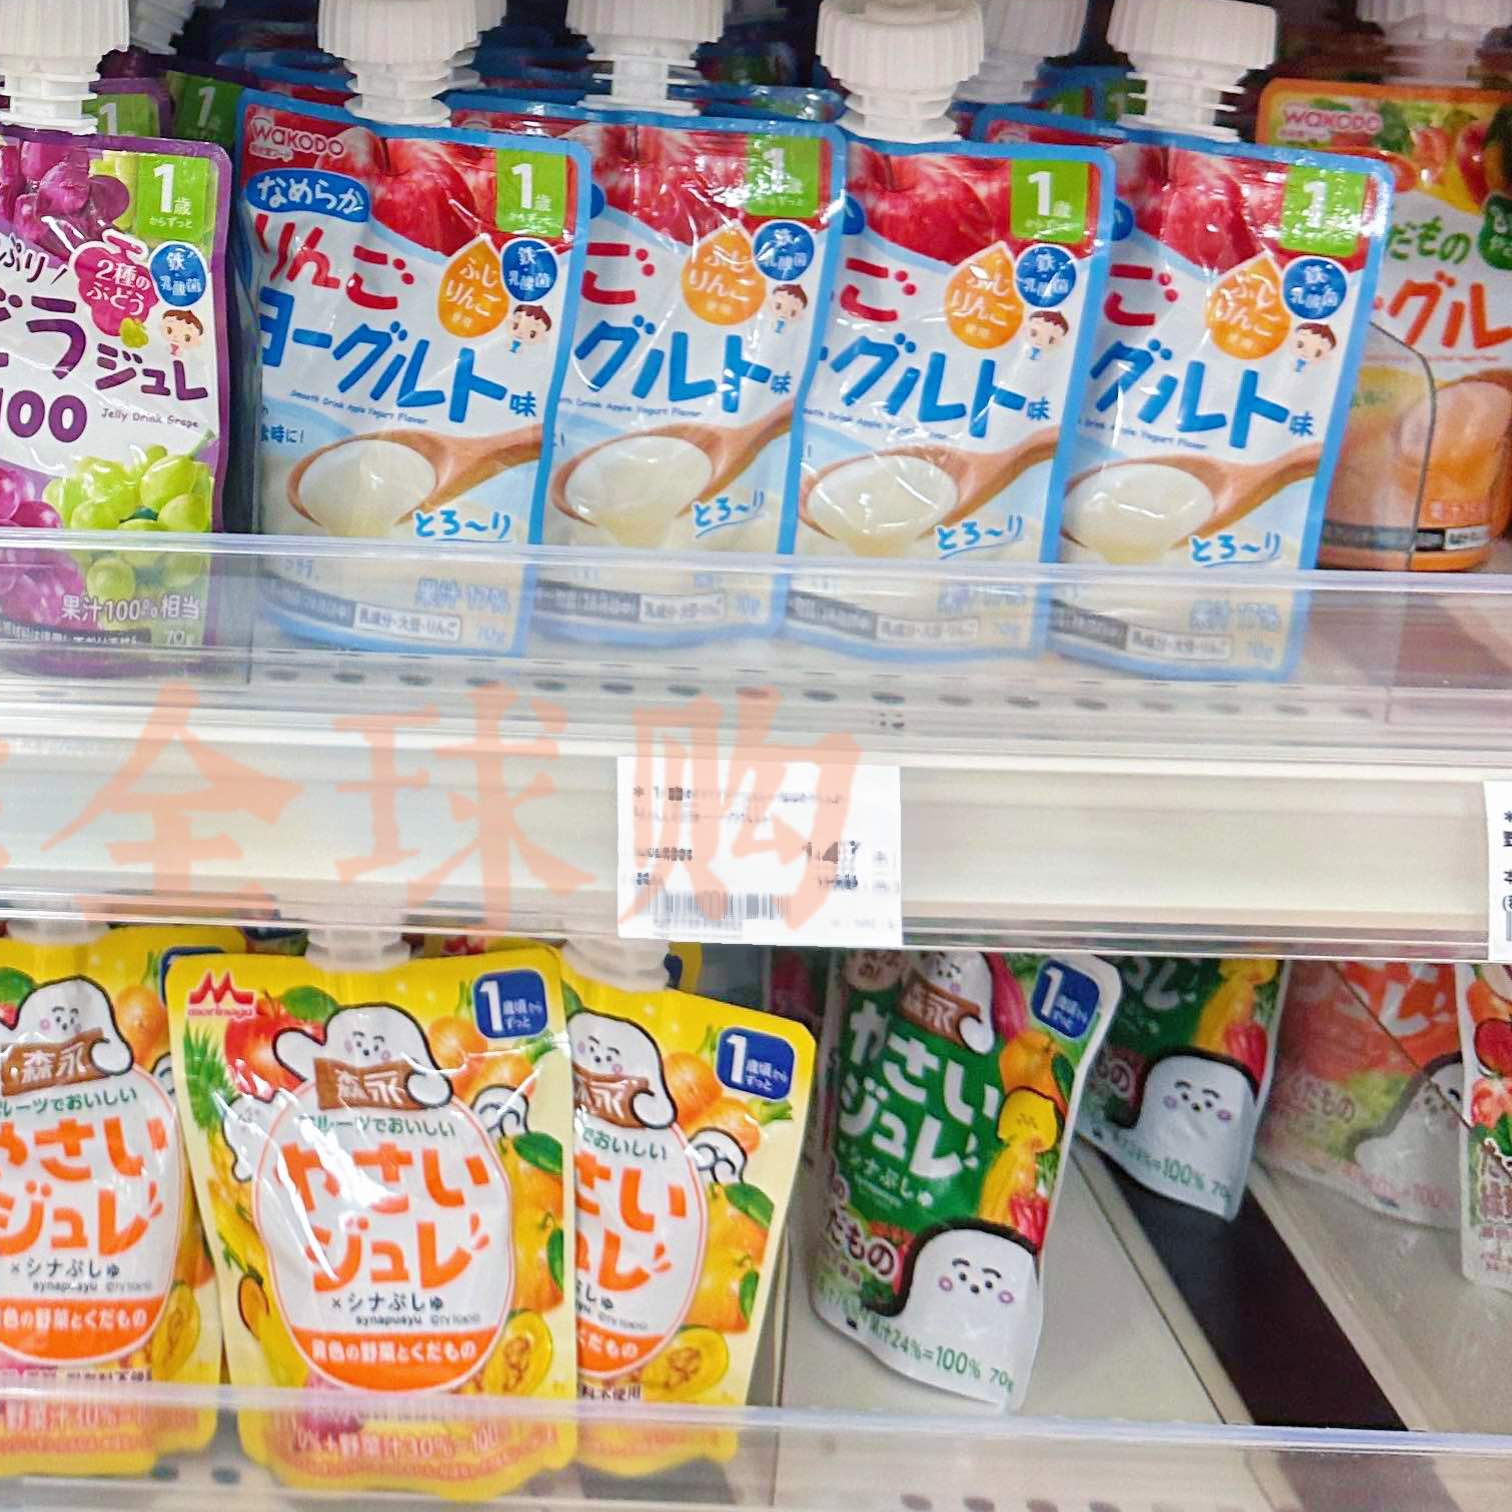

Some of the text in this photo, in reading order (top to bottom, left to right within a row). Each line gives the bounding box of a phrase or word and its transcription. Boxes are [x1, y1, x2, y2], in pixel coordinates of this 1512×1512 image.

[153, 163, 192, 216] 1歳
[256, 176, 366, 214] なめらか
[511, 162, 552, 214] 1歳
[95, 259, 149, 288] 2種の
[255, 212, 416, 312] りんご
[508, 268, 552, 291] 乳酸菌
[84, 282, 146, 317] ぶどう
[445, 284, 502, 317] りんご
[574, 314, 792, 413] グルト味
[1090, 338, 1315, 452] グルト味
[61, 594, 202, 624] 果汁100%相当
[21, 1047, 89, 1085] 森永
[274, 1142, 489, 1216] やさい
[304, 1216, 491, 1294] ジュレ
